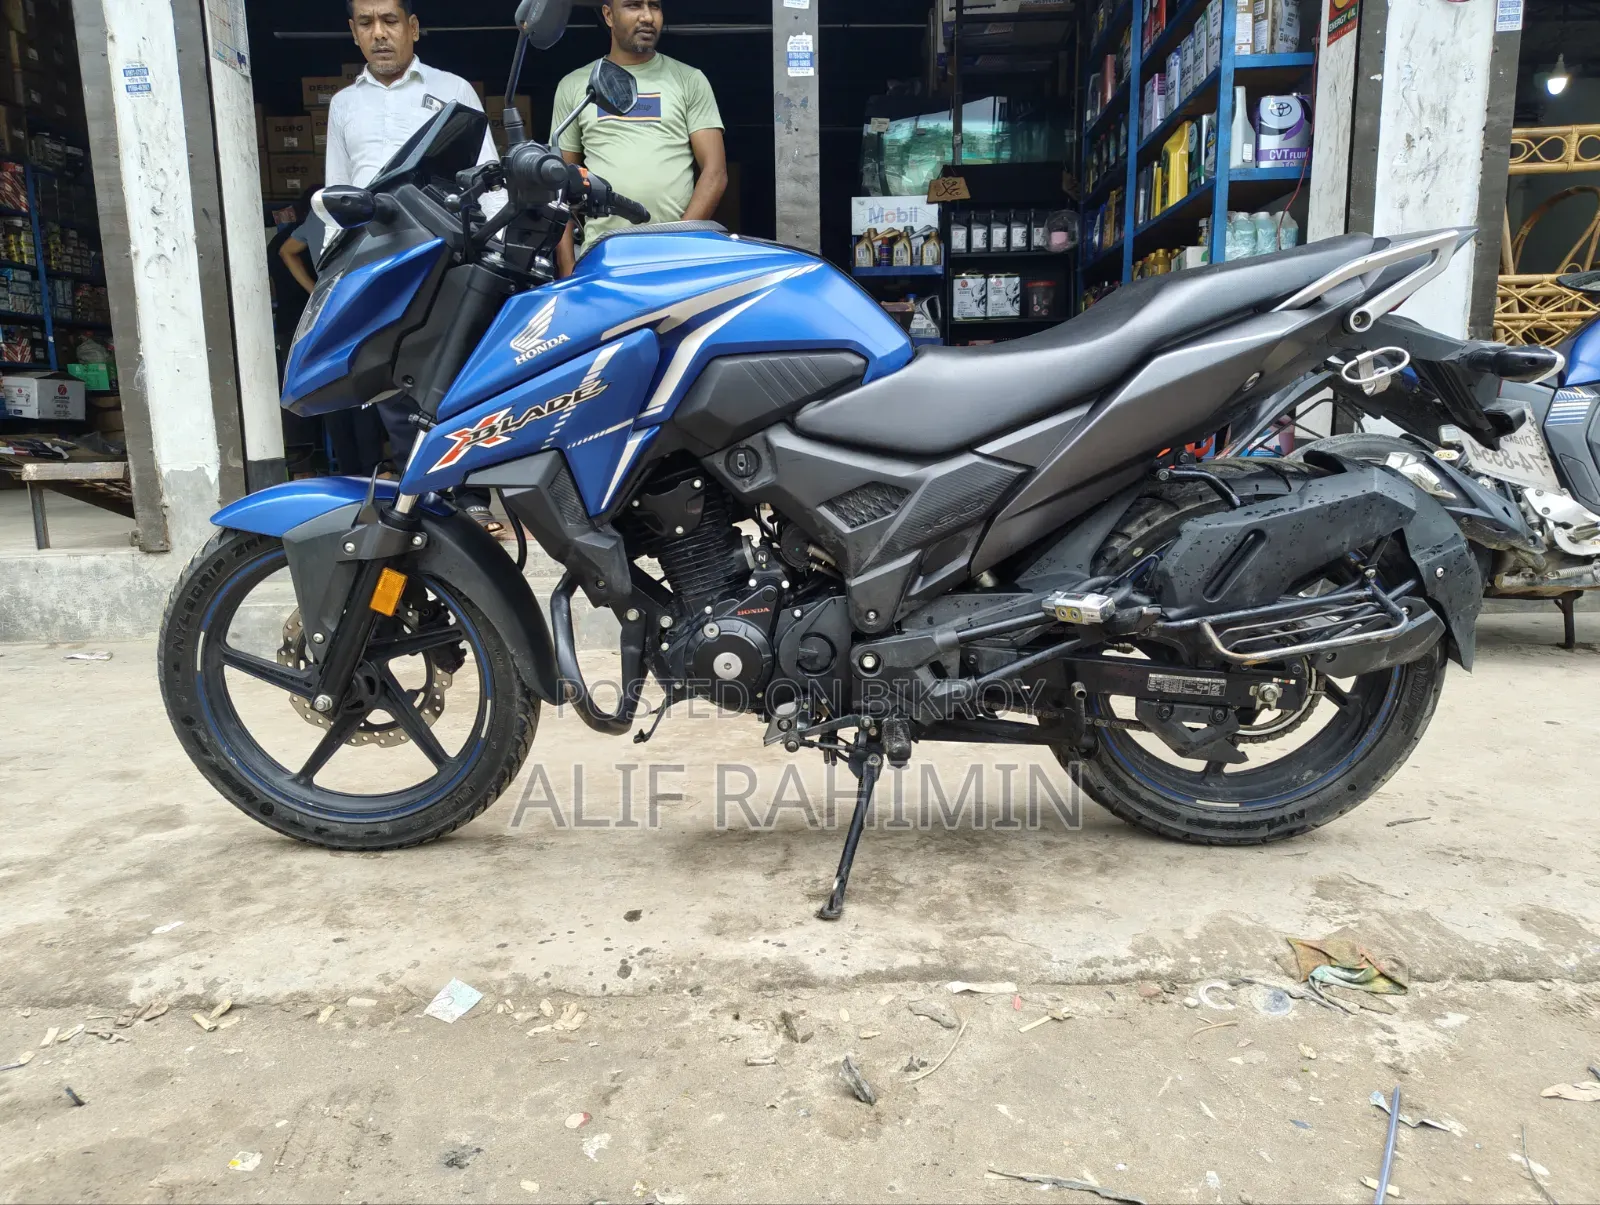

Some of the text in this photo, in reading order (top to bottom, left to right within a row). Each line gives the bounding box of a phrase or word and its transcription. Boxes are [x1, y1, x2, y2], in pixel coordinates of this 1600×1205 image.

[1328, 12, 1348, 33] ENERGY
[309, 83, 339, 92] DEPO
[274, 124, 304, 133] DEPO
[1269, 148, 1290, 160] CVT
[868, 206, 919, 224] Mobil
[514, 332, 571, 366] HONDA
[758, 554, 766, 562] N
[736, 606, 771, 617] HONDA
